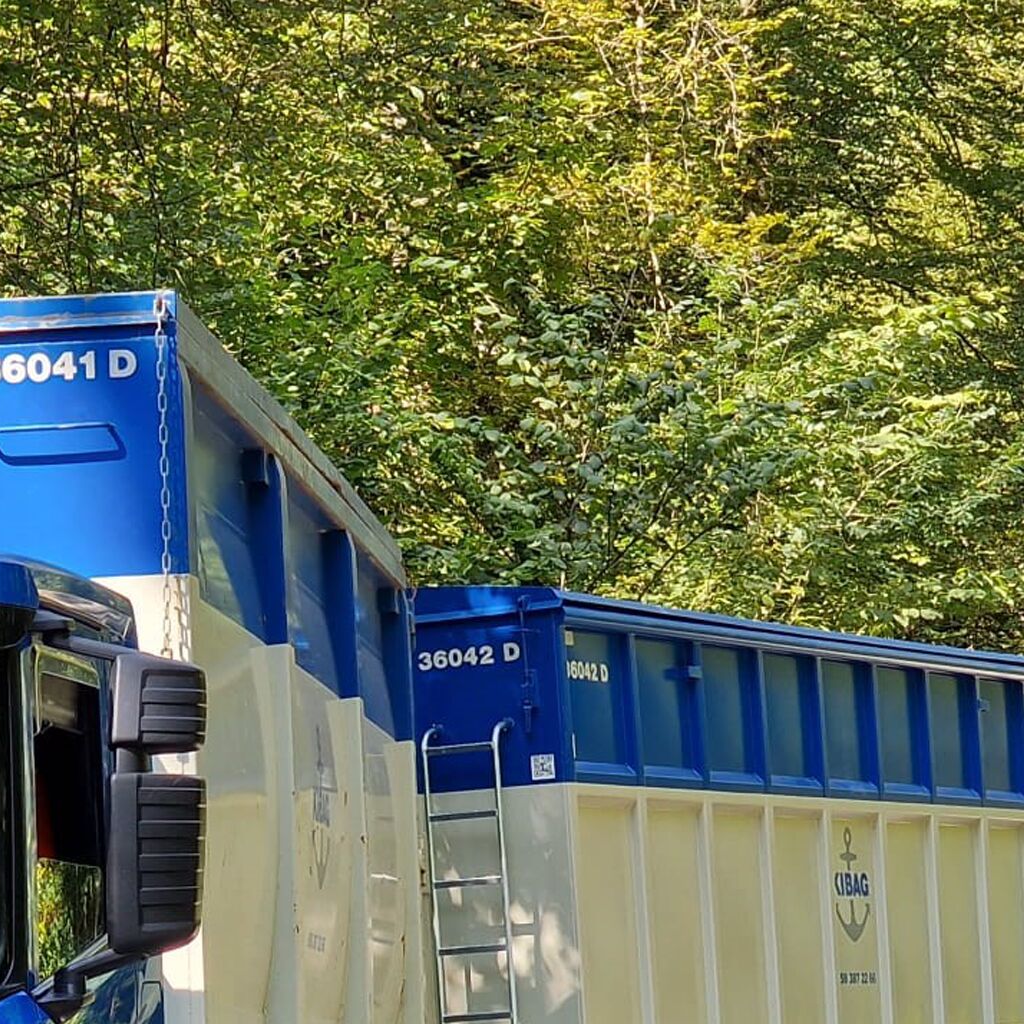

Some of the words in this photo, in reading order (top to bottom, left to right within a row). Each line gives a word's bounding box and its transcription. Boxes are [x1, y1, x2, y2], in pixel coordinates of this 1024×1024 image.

[109, 349, 137, 378] D
[418, 646, 494, 671] 36042
[503, 643, 520, 662] D
[600, 663, 609, 682] D
